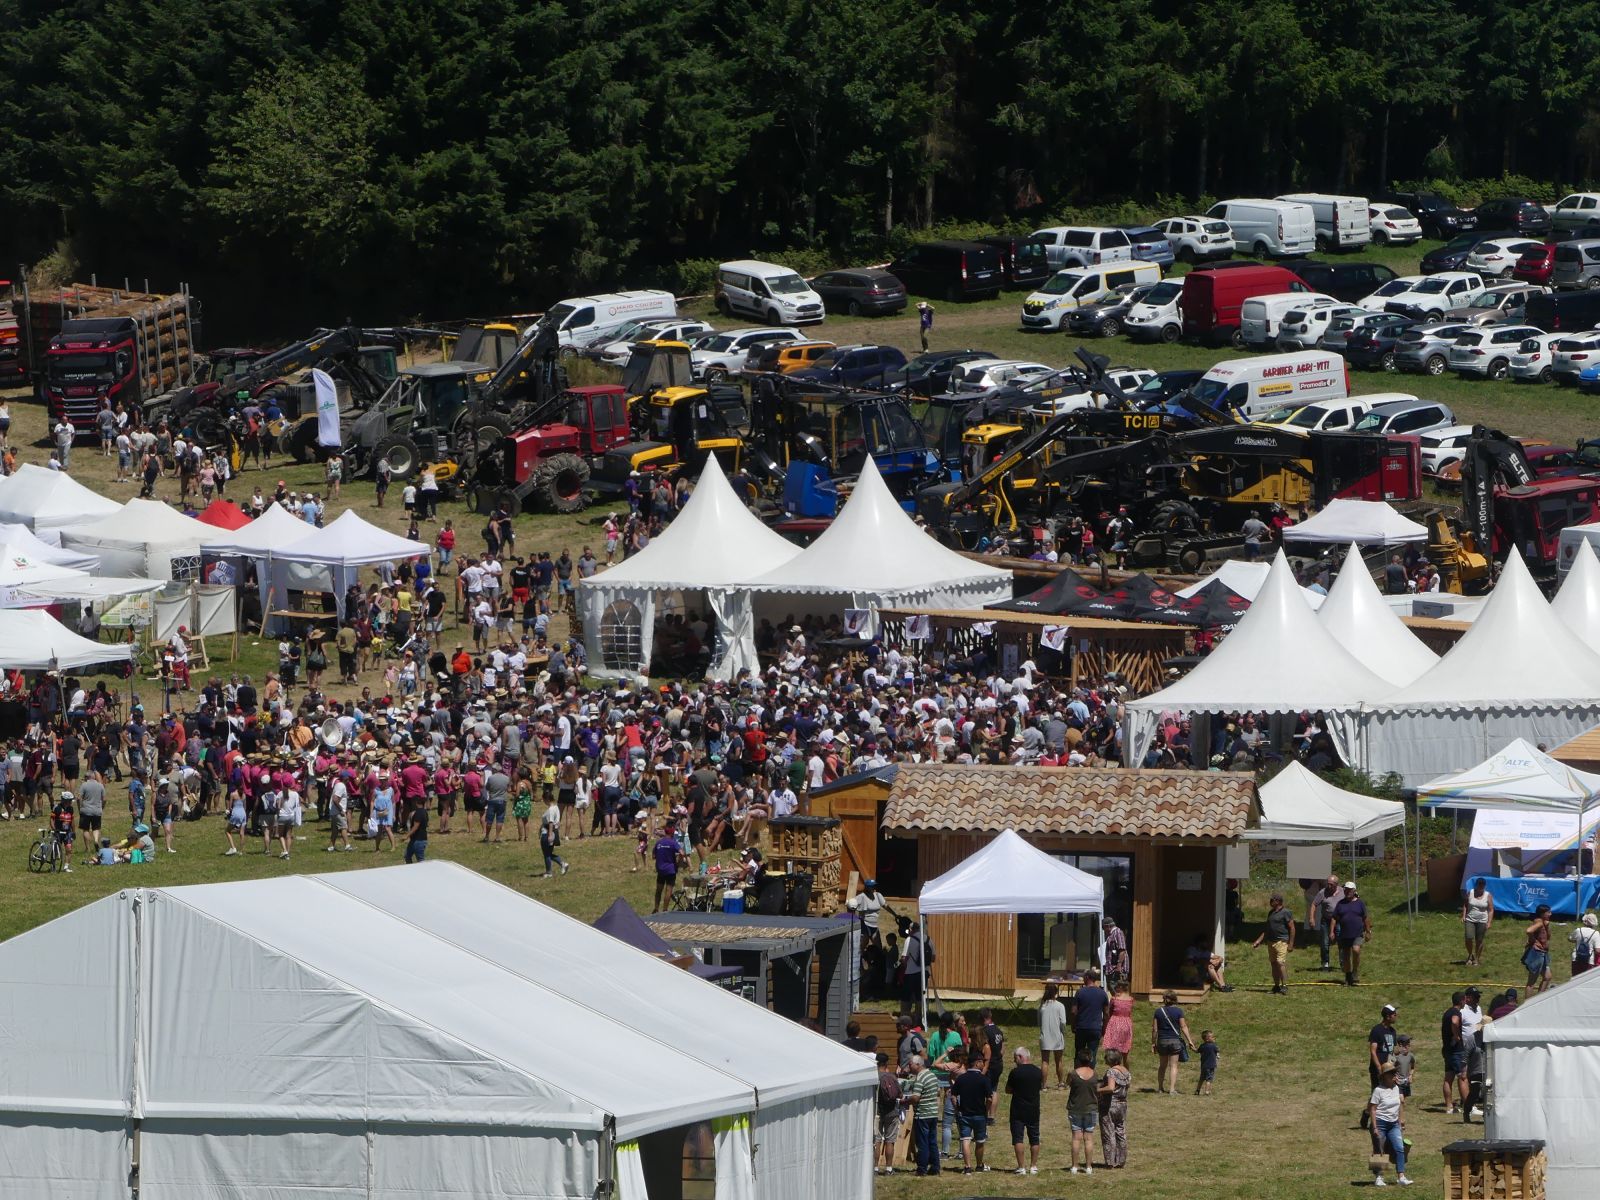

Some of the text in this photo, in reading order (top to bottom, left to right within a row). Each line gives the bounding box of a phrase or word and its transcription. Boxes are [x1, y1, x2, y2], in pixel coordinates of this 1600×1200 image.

[1262, 365, 1294, 378] GARNIER
[1123, 415, 1147, 429] TCI
[1505, 759, 1531, 767] ALTE
[1527, 887, 1546, 895] ALTE
